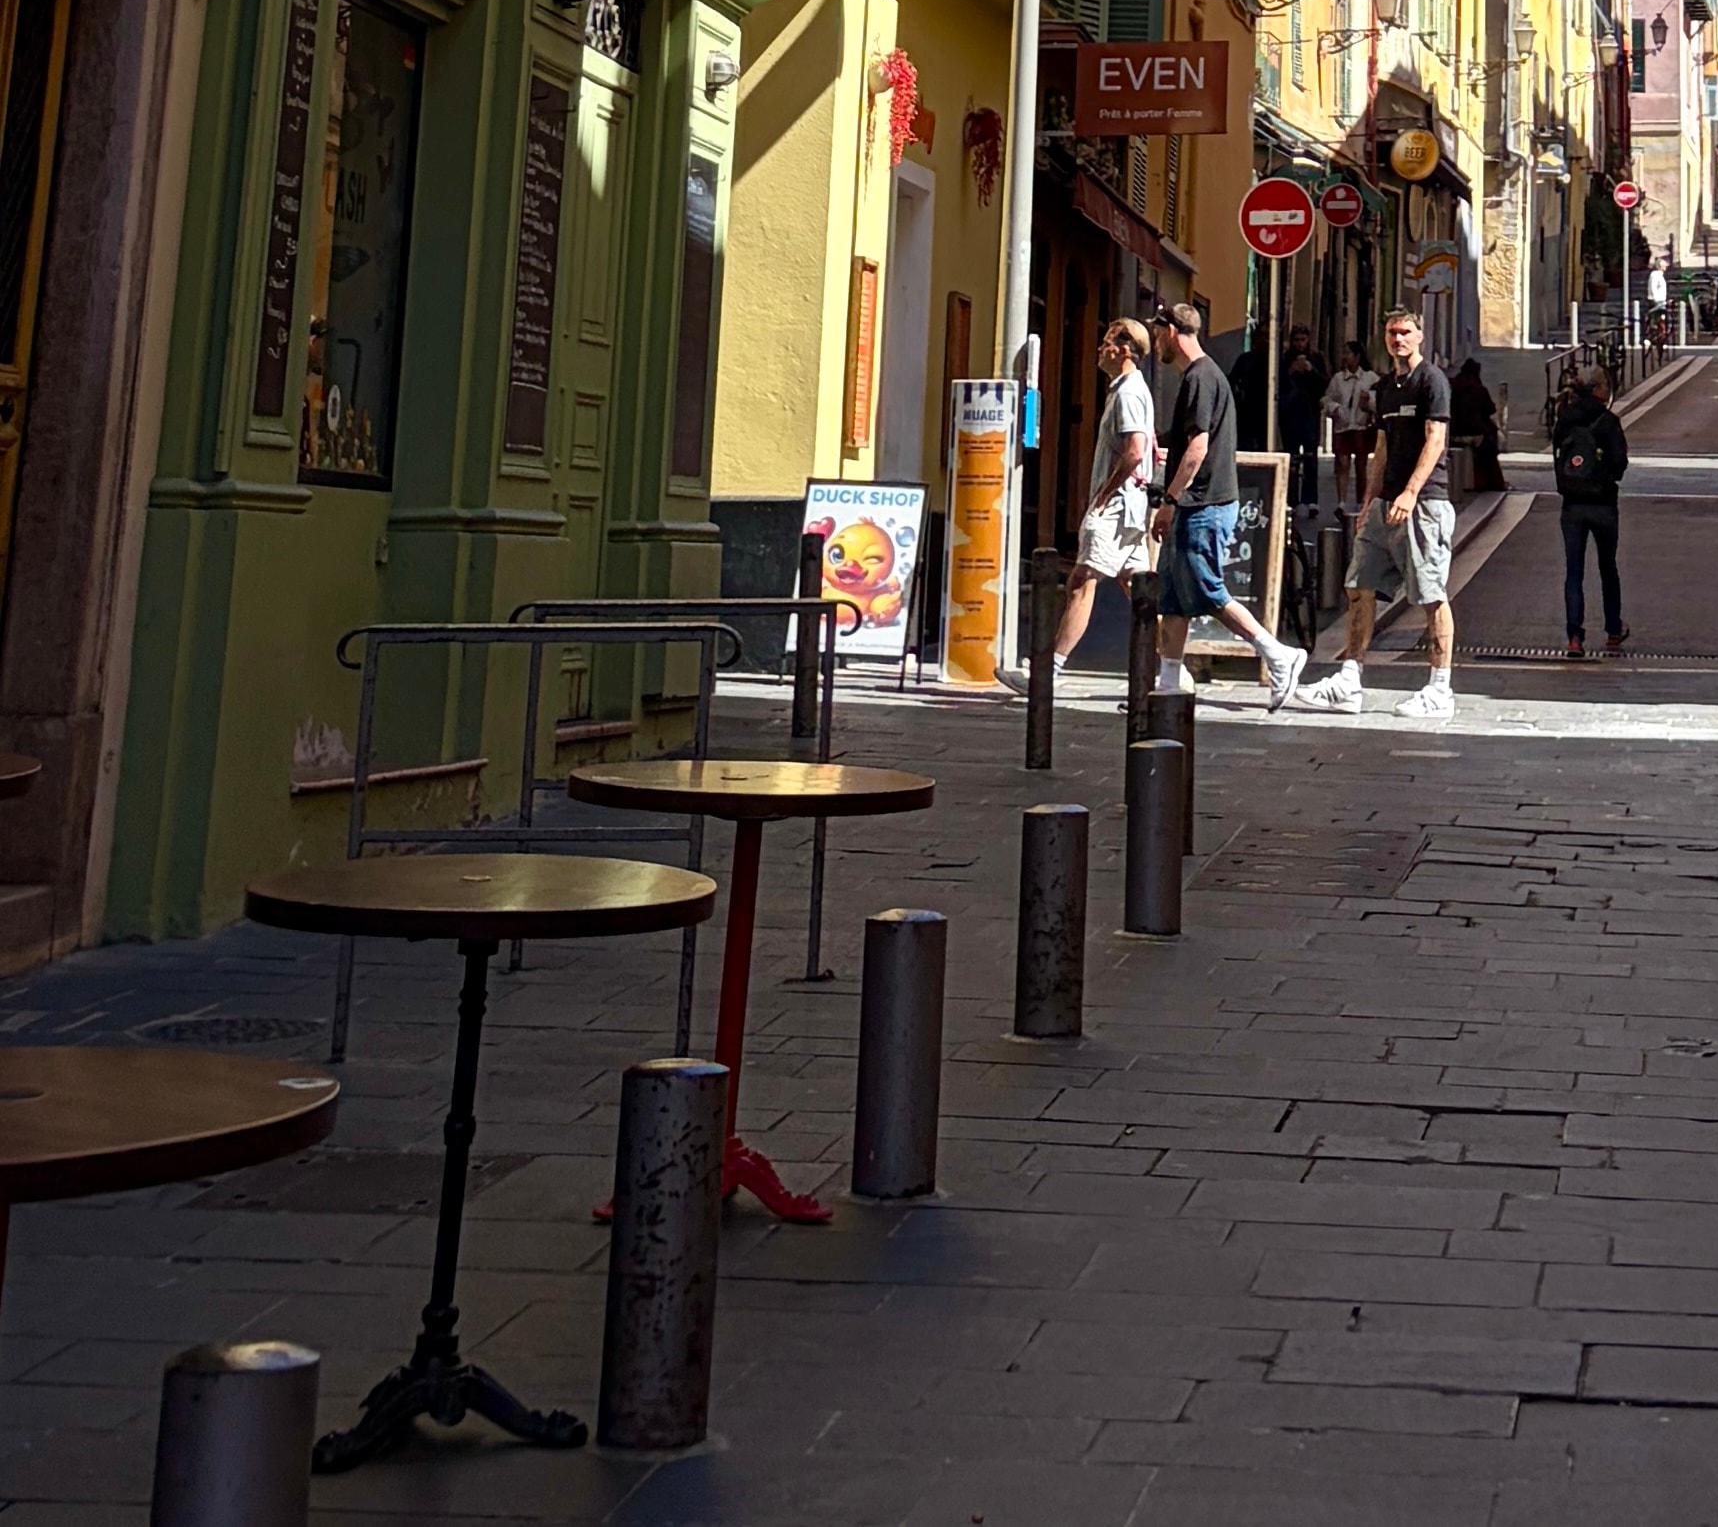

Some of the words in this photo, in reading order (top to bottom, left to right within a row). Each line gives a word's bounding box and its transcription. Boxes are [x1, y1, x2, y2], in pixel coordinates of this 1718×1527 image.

[1098, 56, 1206, 91] EVEN
[1133, 109, 1164, 120] porter
[1167, 108, 1203, 118] Femme
[963, 409, 1005, 421] NUAGE
[812, 488, 866, 505] DUCK
[869, 491, 920, 508] SHOP
